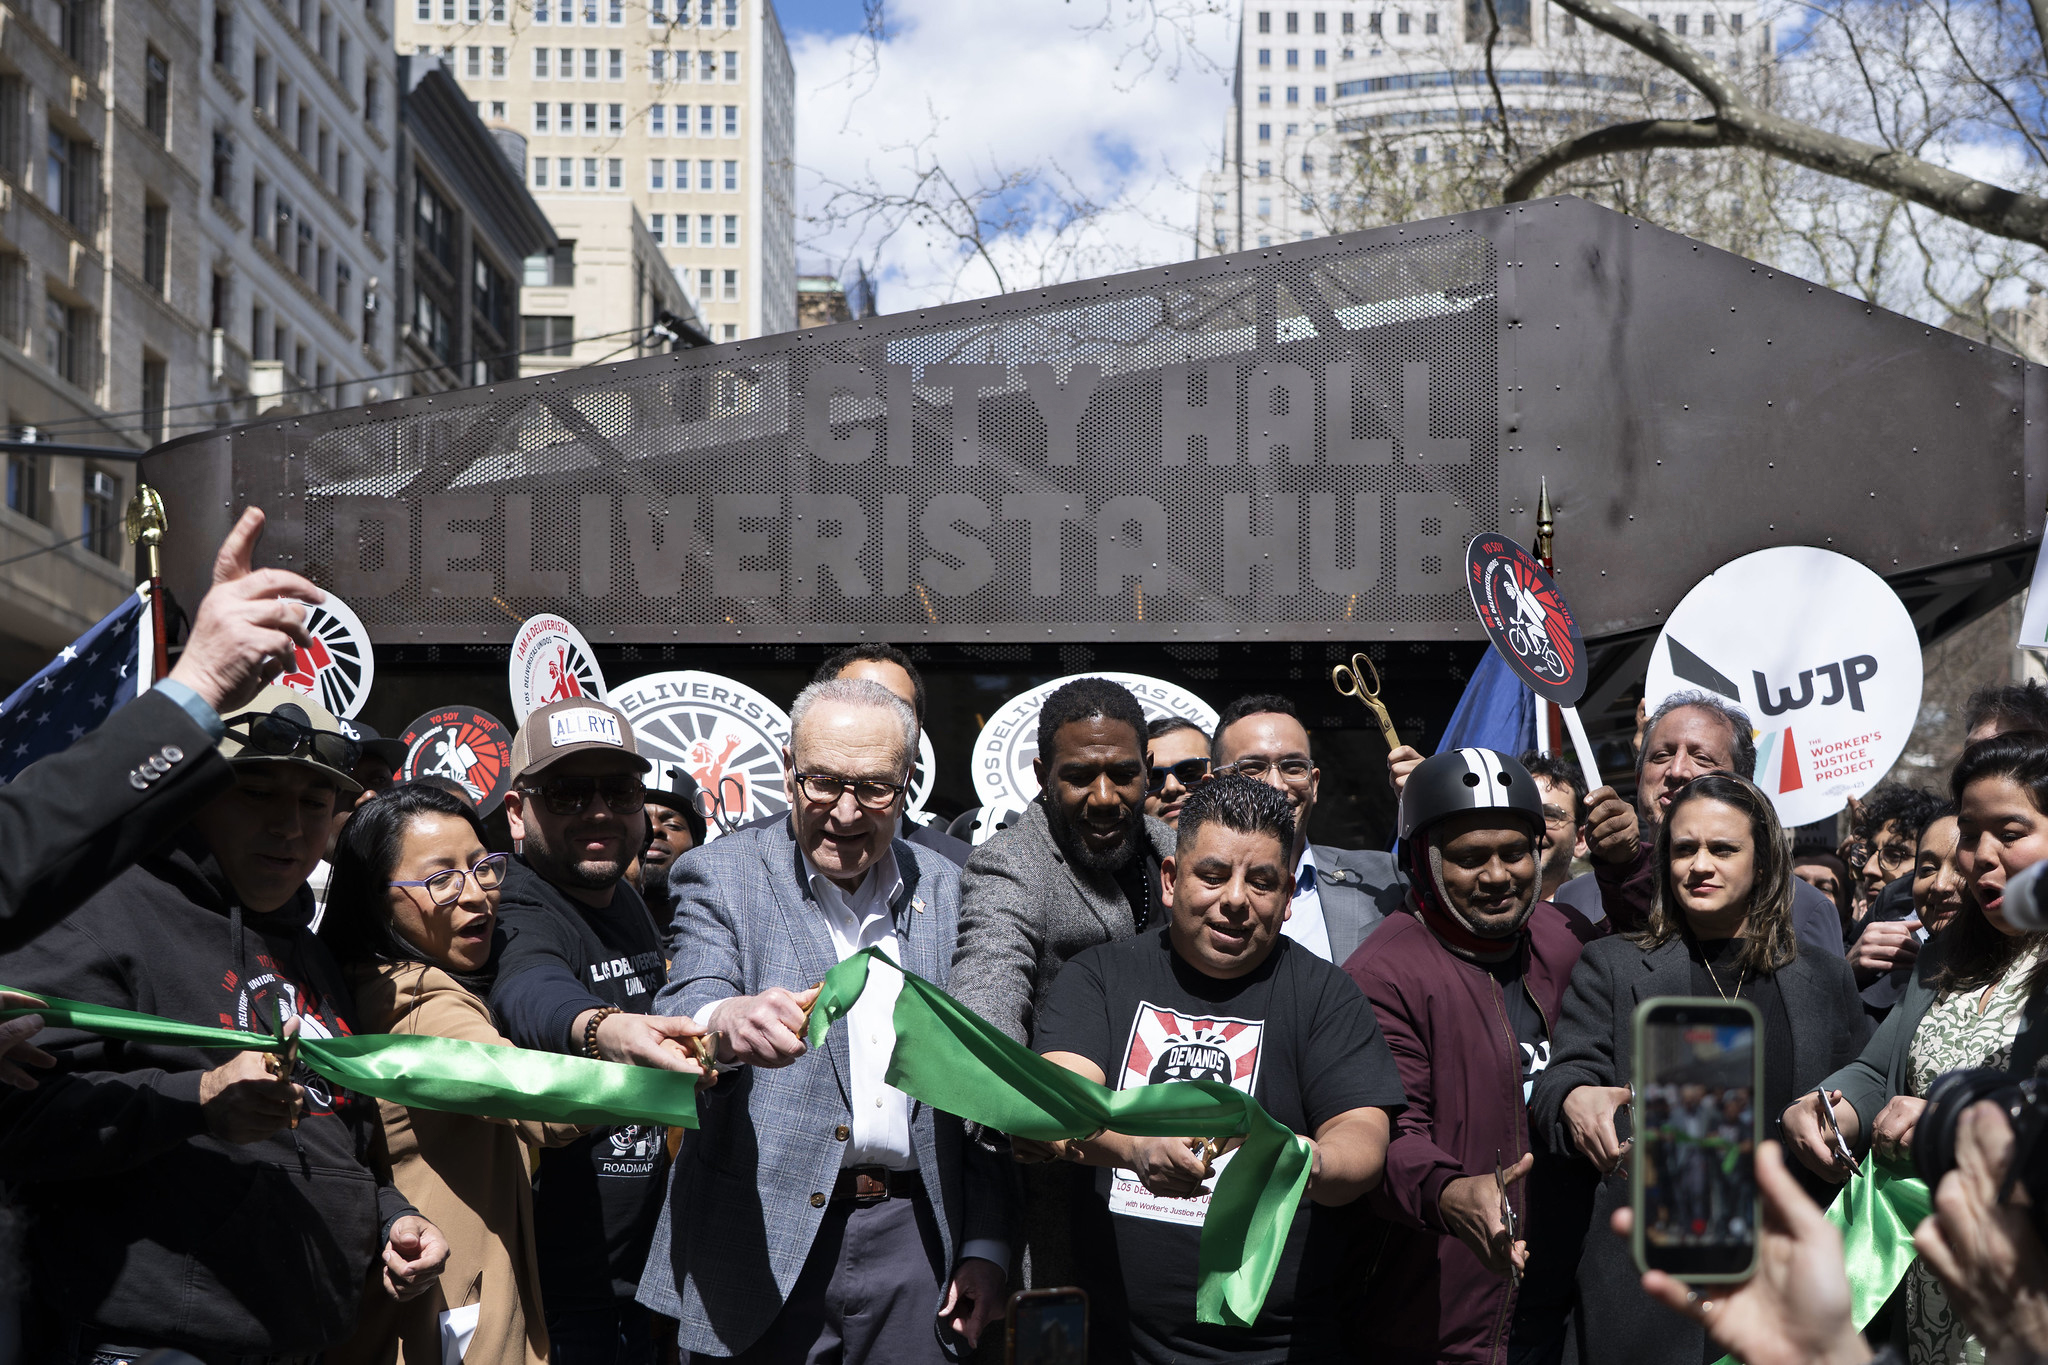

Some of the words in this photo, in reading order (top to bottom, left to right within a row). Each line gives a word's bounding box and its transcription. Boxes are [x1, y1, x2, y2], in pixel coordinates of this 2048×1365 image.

[802, 362, 1101, 467] CITY
[1161, 361, 1471, 467] HALL
[332, 492, 1168, 598] DELIVERISTA
[1223, 492, 1471, 597] HUB
[1550, 590, 1559, 600] JE
[1558, 602, 1573, 625] SUIS
[1494, 616, 1504, 630] LOS
[518, 639, 528, 657] AM
[530, 620, 569, 637] DELIVERISTA
[524, 647, 538, 688] DELIVERISTAS
[537, 636, 552, 650] UNIDOS
[1752, 654, 1878, 716] WJP
[430, 714, 442, 724] YO
[443, 712, 459, 721] SOY
[557, 715, 615, 736] ALLRYT
[612, 682, 791, 748] ELIVERISTA
[497, 740, 505, 750] JE
[1808, 738, 1822, 746] THE
[1810, 731, 1882, 757] WORKER'S
[500, 750, 510, 768] SUIS
[1813, 748, 1867, 770] JUSTICE
[984, 757, 1009, 799] LOS
[1815, 759, 1875, 782] PROJECT
[223, 970, 238, 989] AM
[248, 973, 276, 990] UNIDOS
[1168, 1047, 1226, 1071] DEMANDS
[603, 1162, 654, 1173] ROADMAP
[1117, 1182, 1131, 1192] LOS
[1125, 1200, 1138, 1208] with
[1139, 1202, 1168, 1213] Worker's
[1170, 1207, 1195, 1217] Justice
